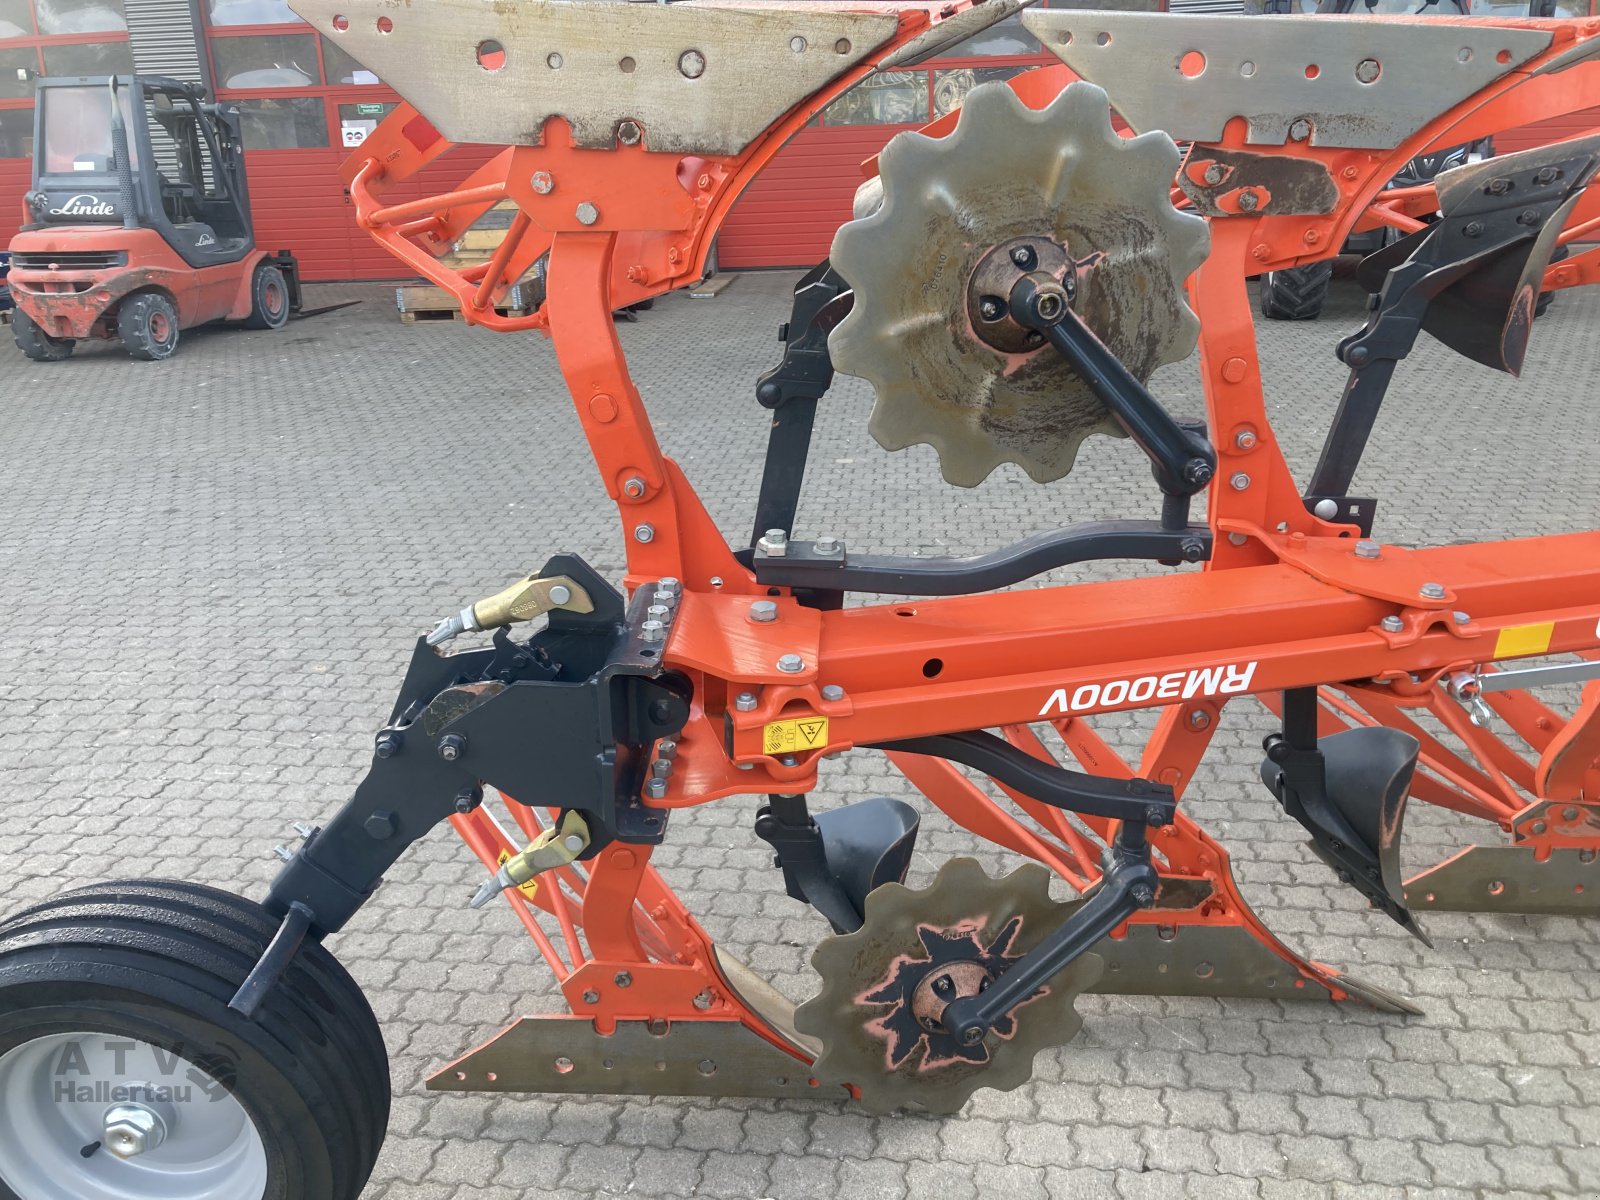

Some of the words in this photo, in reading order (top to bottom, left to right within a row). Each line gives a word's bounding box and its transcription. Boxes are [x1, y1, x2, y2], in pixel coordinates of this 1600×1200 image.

[50, 195, 114, 215] Linde
[195, 233, 215, 246] Linde
[1038, 661, 1258, 716] RM3000V
